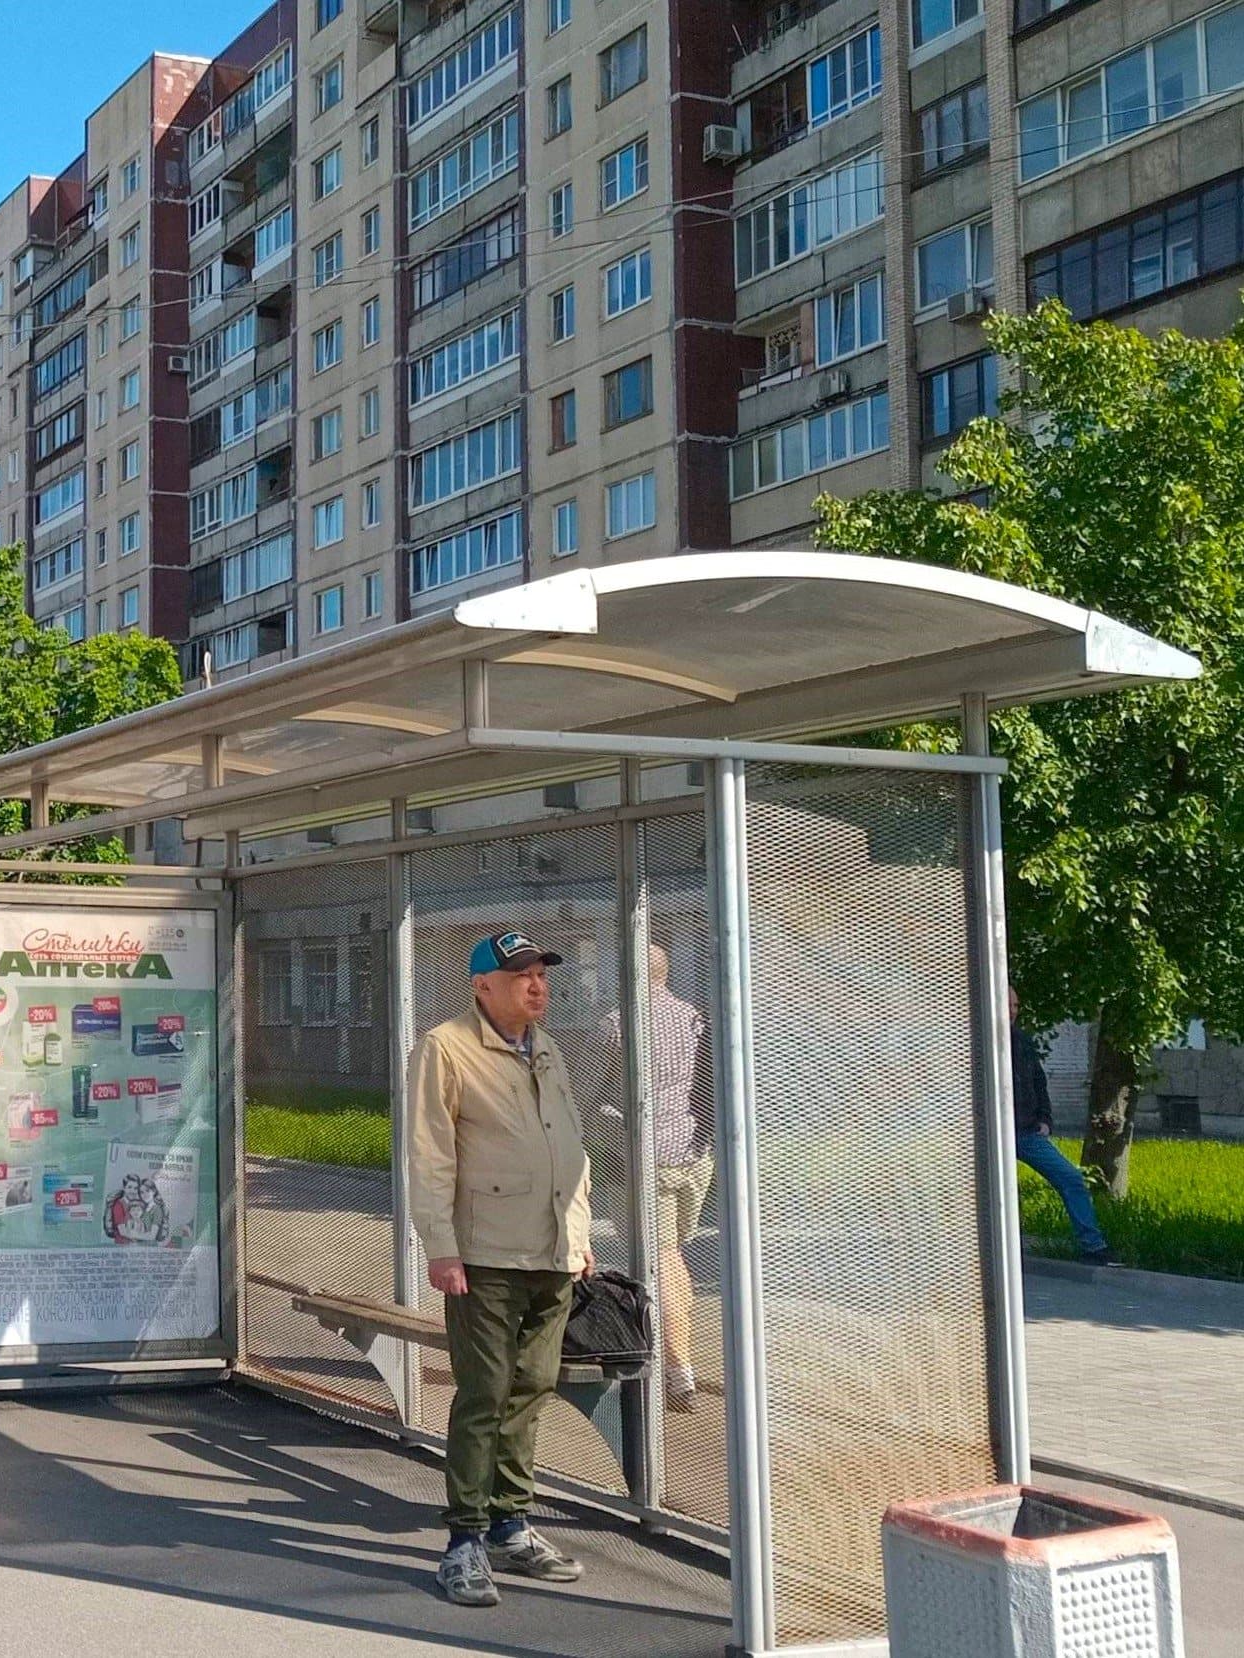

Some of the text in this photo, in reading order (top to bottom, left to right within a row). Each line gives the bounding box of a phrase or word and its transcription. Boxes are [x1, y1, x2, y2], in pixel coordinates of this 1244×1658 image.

[22, 928, 144, 951] Столички
[30, 1008, 53, 1021] -20%
[159, 1018, 182, 1030] -20%
[95, 1086, 117, 1098] -20%
[129, 1081, 153, 1093] -20%
[57, 1192, 77, 1205] -20%
[36, 1304, 117, 1322] КОНСУЛЬТАЦИИ
